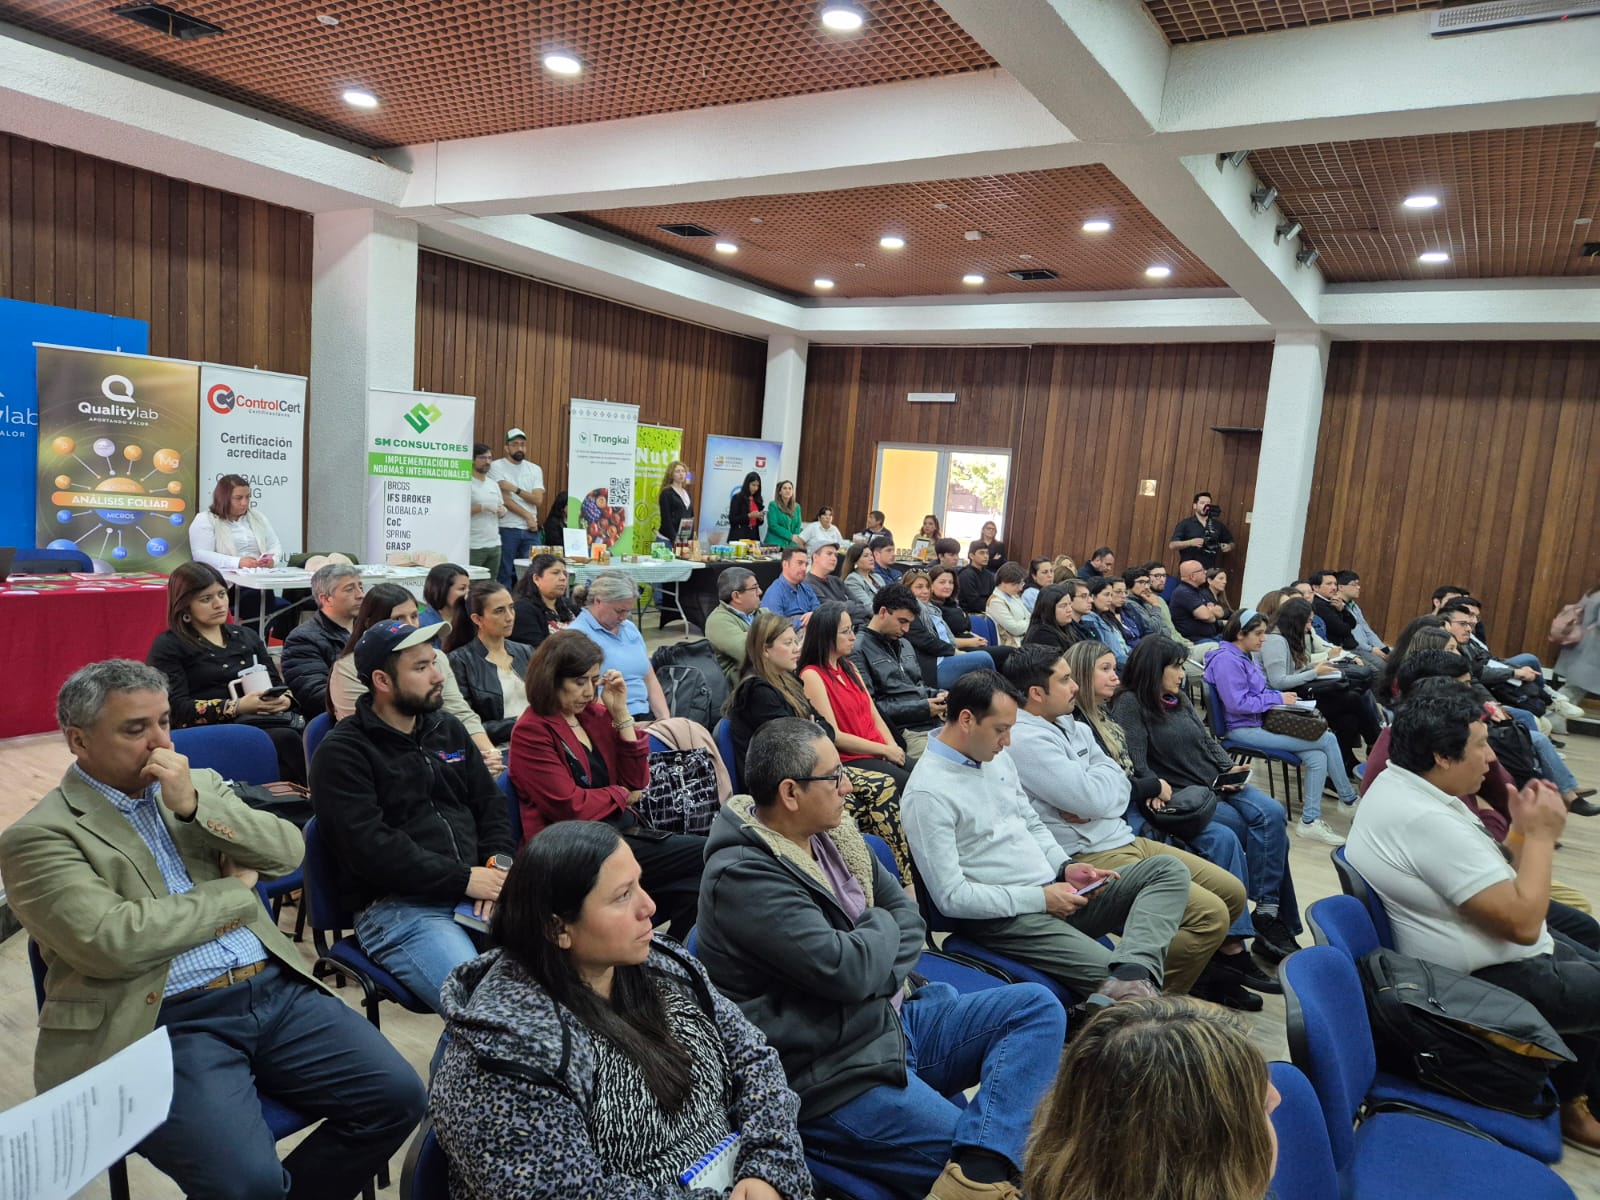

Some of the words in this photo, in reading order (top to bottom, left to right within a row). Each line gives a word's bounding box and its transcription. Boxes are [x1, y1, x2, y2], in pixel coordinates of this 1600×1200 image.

[235, 394, 301, 414] ControlCert
[78, 401, 159, 421] Qualitylab
[0, 430, 25, 438] ALOR
[220, 432, 293, 448] Certificación
[593, 433, 630, 446] Trongkai
[374, 437, 391, 447] SM
[393, 439, 469, 453] CONSULTORES
[226, 448, 287, 461] acreditada
[450, 460, 459, 469] DE
[373, 464, 405, 474] NORMAS
[405, 465, 470, 479] INTERNACIONALES
[215, 472, 289, 486] GBALGAP
[387, 480, 410, 491] BRCGS
[71, 493, 125, 506] ANÁLISIS
[127, 497, 169, 509] FOLIAR
[387, 493, 400, 503] IFS
[401, 494, 432, 504] BROKER
[106, 512, 135, 520] MICROS
[386, 517, 402, 527] CoC
[386, 529, 411, 539] SPRING
[152, 543, 165, 552] Zn
[385, 541, 411, 551] GRASP
